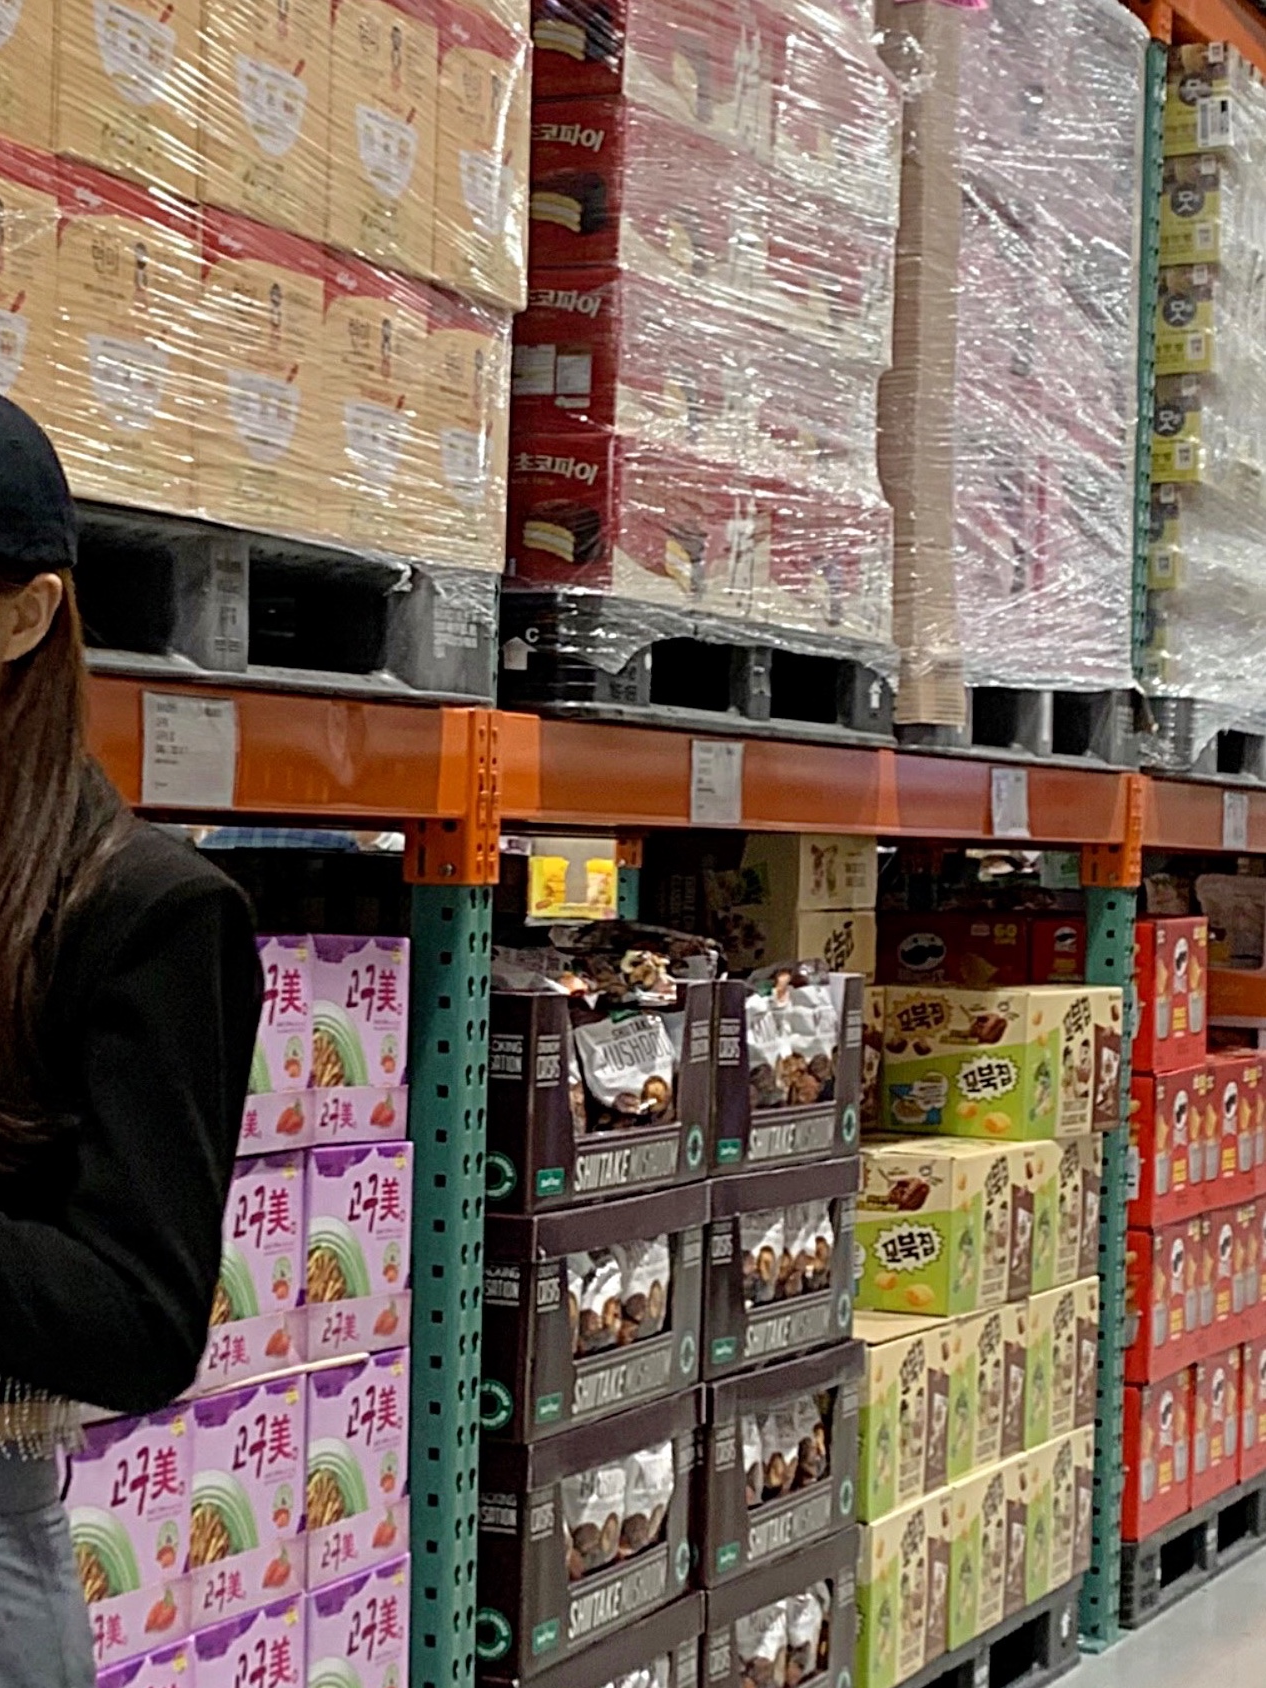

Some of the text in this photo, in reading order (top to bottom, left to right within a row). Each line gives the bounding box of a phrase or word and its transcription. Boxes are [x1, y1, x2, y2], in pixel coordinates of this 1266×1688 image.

[526, 627, 540, 643] C
[961, 1062, 1014, 1093] 꼬북칩
[882, 1231, 935, 1262] 꼬북칩
